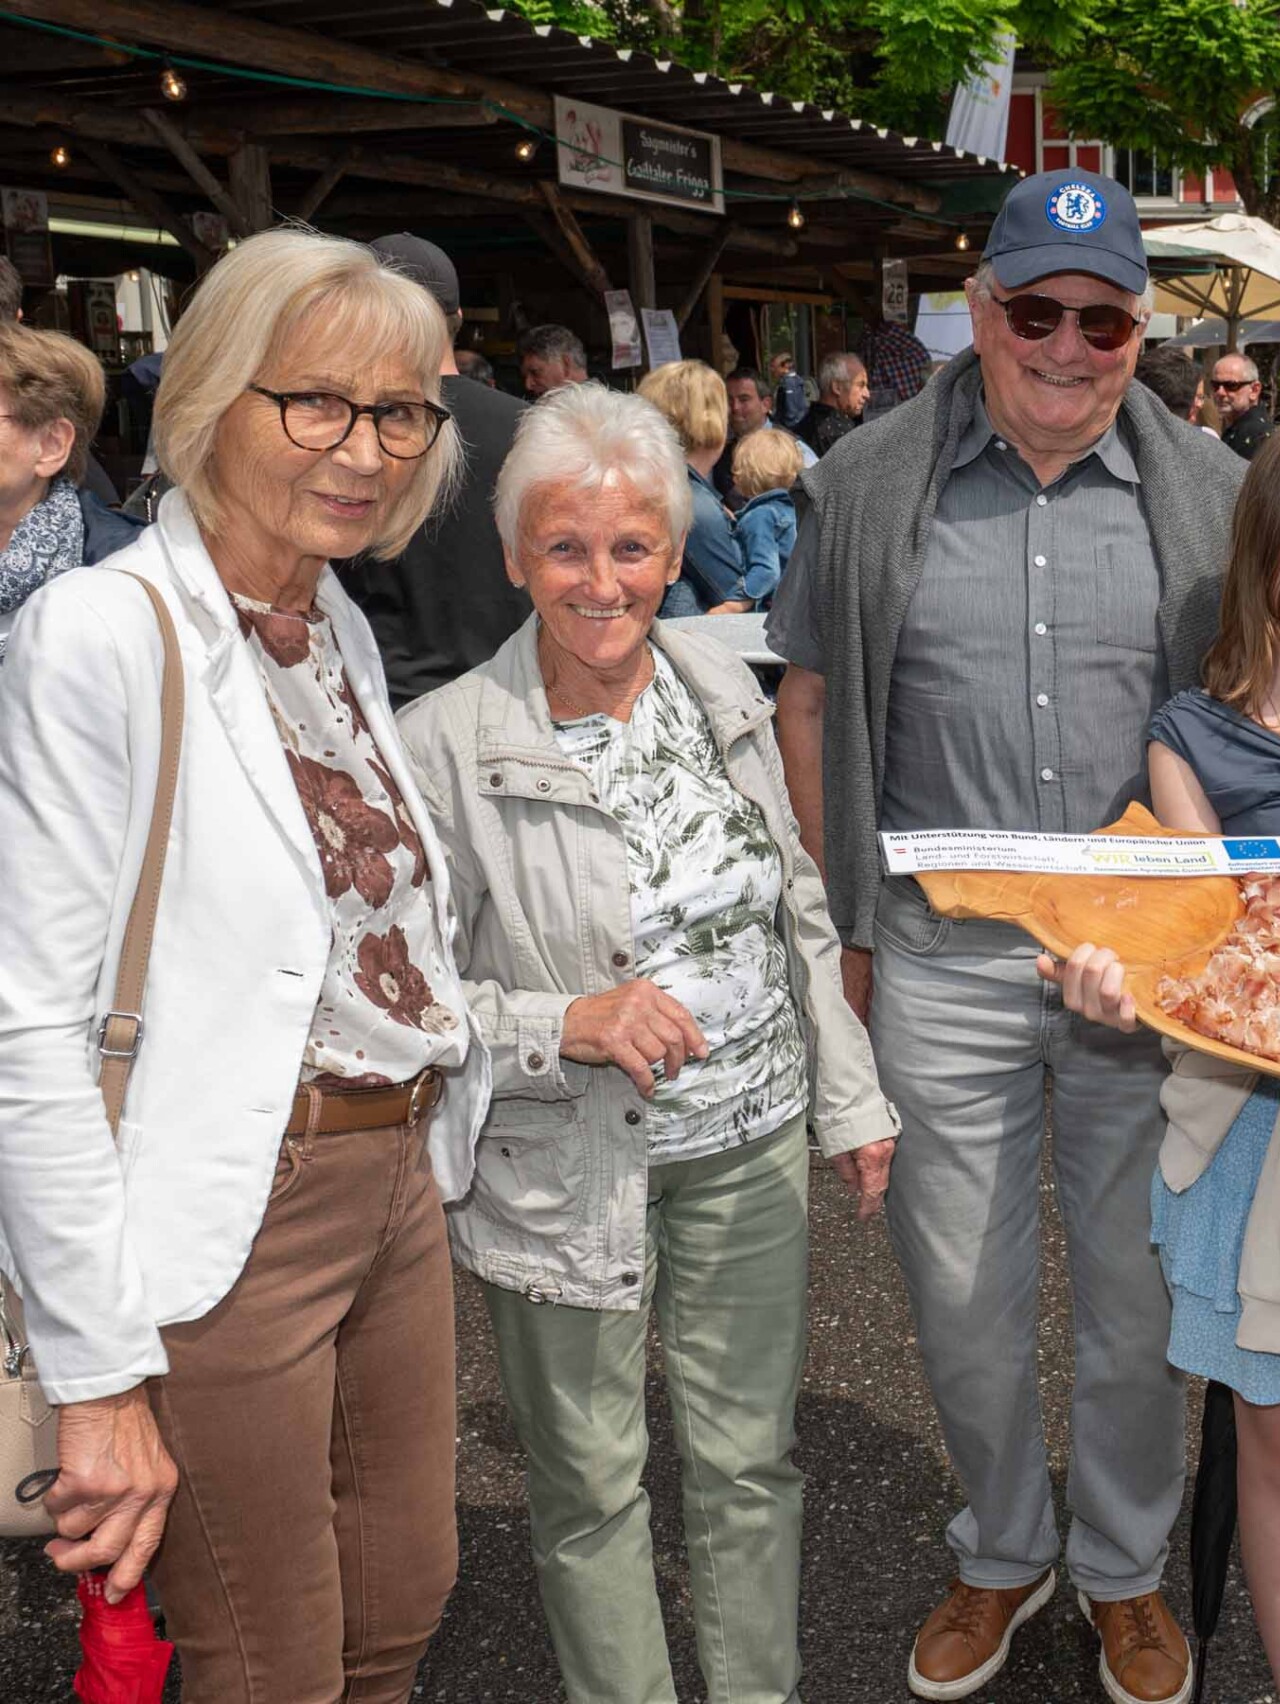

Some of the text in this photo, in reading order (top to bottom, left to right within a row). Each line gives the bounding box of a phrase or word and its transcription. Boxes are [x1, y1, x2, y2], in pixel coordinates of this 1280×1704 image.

[1059, 184, 1096, 198] CHELSEA
[911, 831, 987, 840] Unterstützung
[913, 845, 1017, 853] Bundesministerium
[1133, 854, 1171, 863] leben
[1174, 855, 1207, 863] Land
